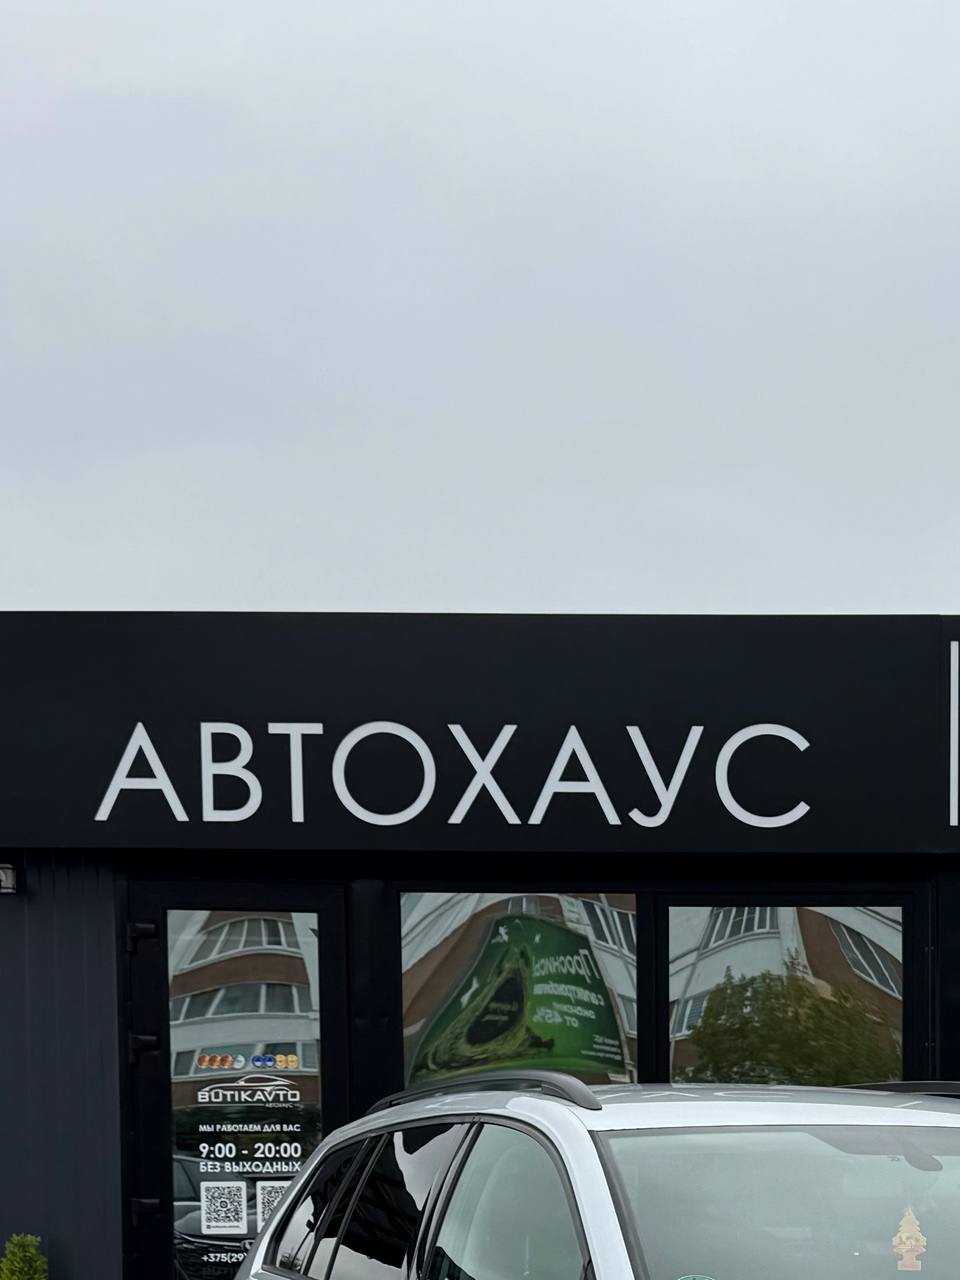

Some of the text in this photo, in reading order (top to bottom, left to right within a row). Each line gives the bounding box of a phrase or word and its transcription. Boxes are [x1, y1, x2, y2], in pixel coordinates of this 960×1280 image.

[94, 720, 811, 828] АВТОХАУС
[197, 1091, 300, 1102] BUTIKAVTO
[199, 1124, 301, 1132] МЫ РАБОТАЕМ ДЛЯ ВАС
[199, 1142, 236, 1158] 9:00
[254, 1142, 302, 1158] 20:00
[200, 1161, 301, 1173] БЕЗ ВЫХОДНЫХ
